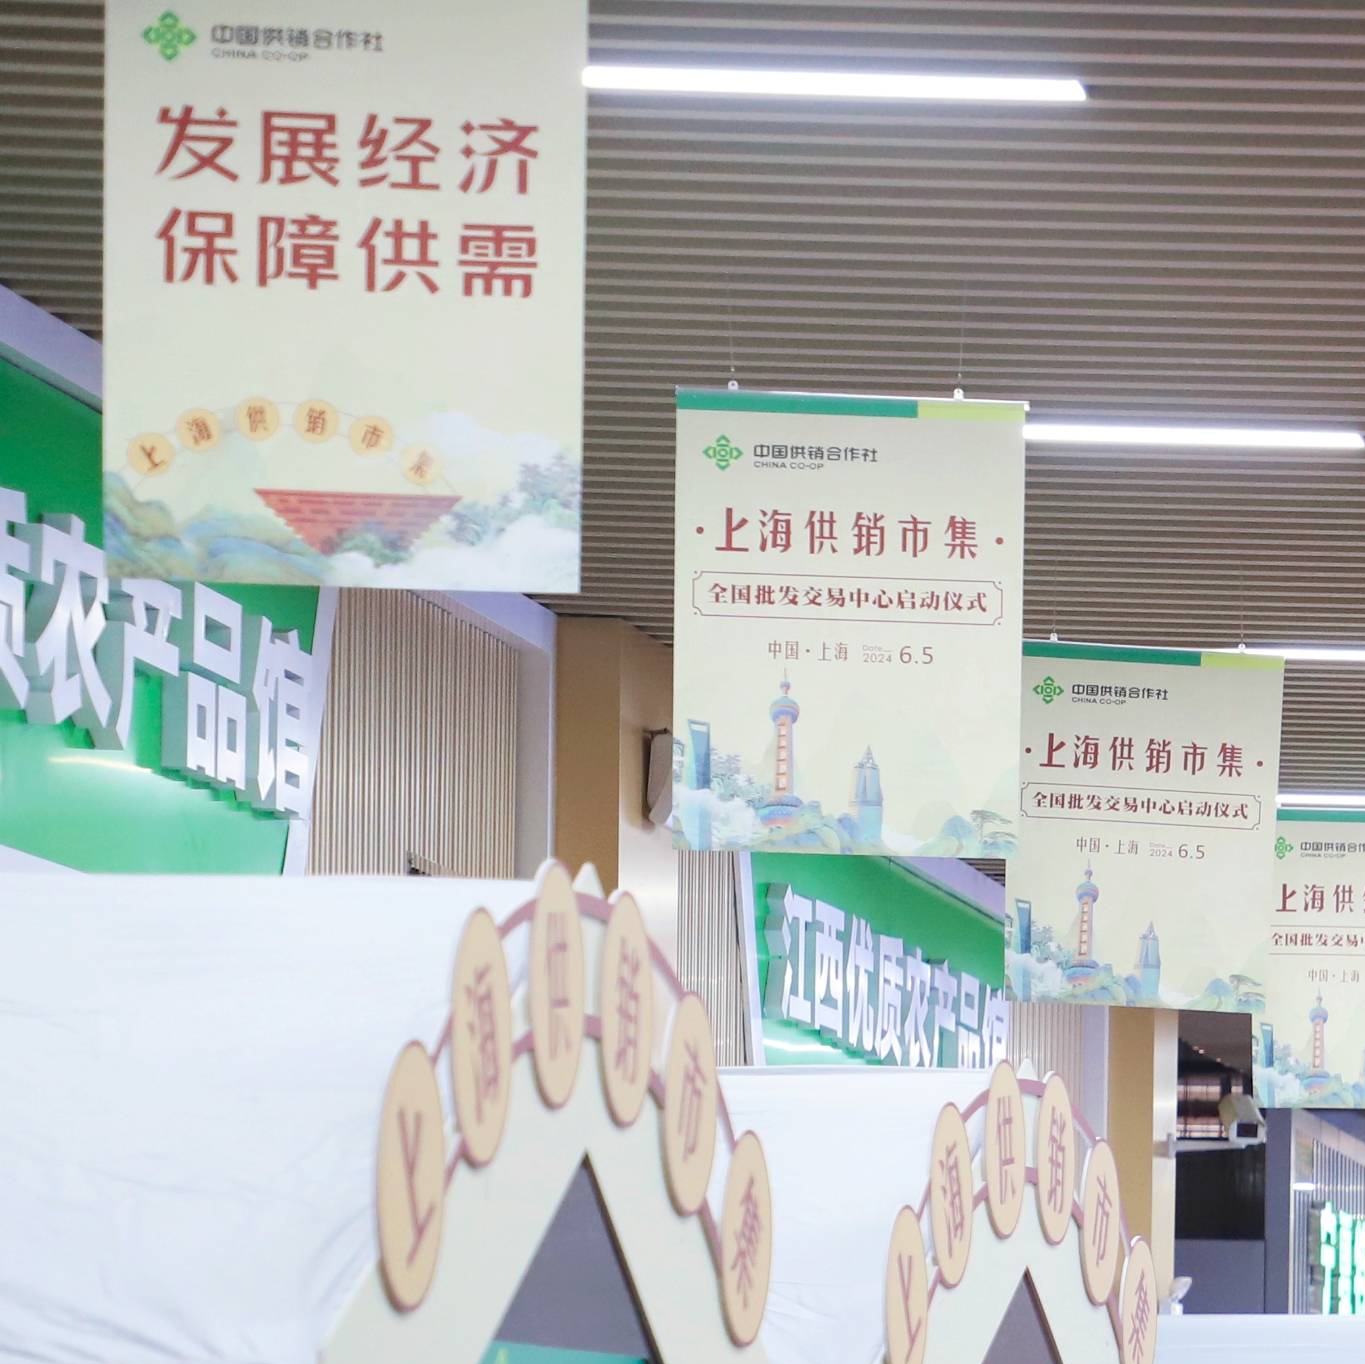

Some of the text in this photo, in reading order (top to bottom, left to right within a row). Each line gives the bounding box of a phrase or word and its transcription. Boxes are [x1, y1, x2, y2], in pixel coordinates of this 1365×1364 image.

[211, 24, 384, 53] 中国供销合作社
[211, 48, 257, 60] CHINA
[155, 103, 540, 195] 发展经济
[155, 208, 540, 299] 保障供需
[753, 443, 878, 464] 中国供销合作社
[753, 461, 787, 470] CHINA
[715, 507, 978, 559] 上海供销市集
[708, 582, 987, 613] 全国批发交易中心启动仪式
[863, 653, 892, 663] 2024
[899, 646, 934, 665] 6.5
[1072, 683, 1168, 701] 中国供销合作社
[1039, 732, 1244, 778] 上海供销市集
[1033, 791, 1249, 819] 全国批发交易中心启动仪式
[1178, 844, 1205, 860] 6.5
[784, 884, 1009, 1068] 江西优质农产品馆
